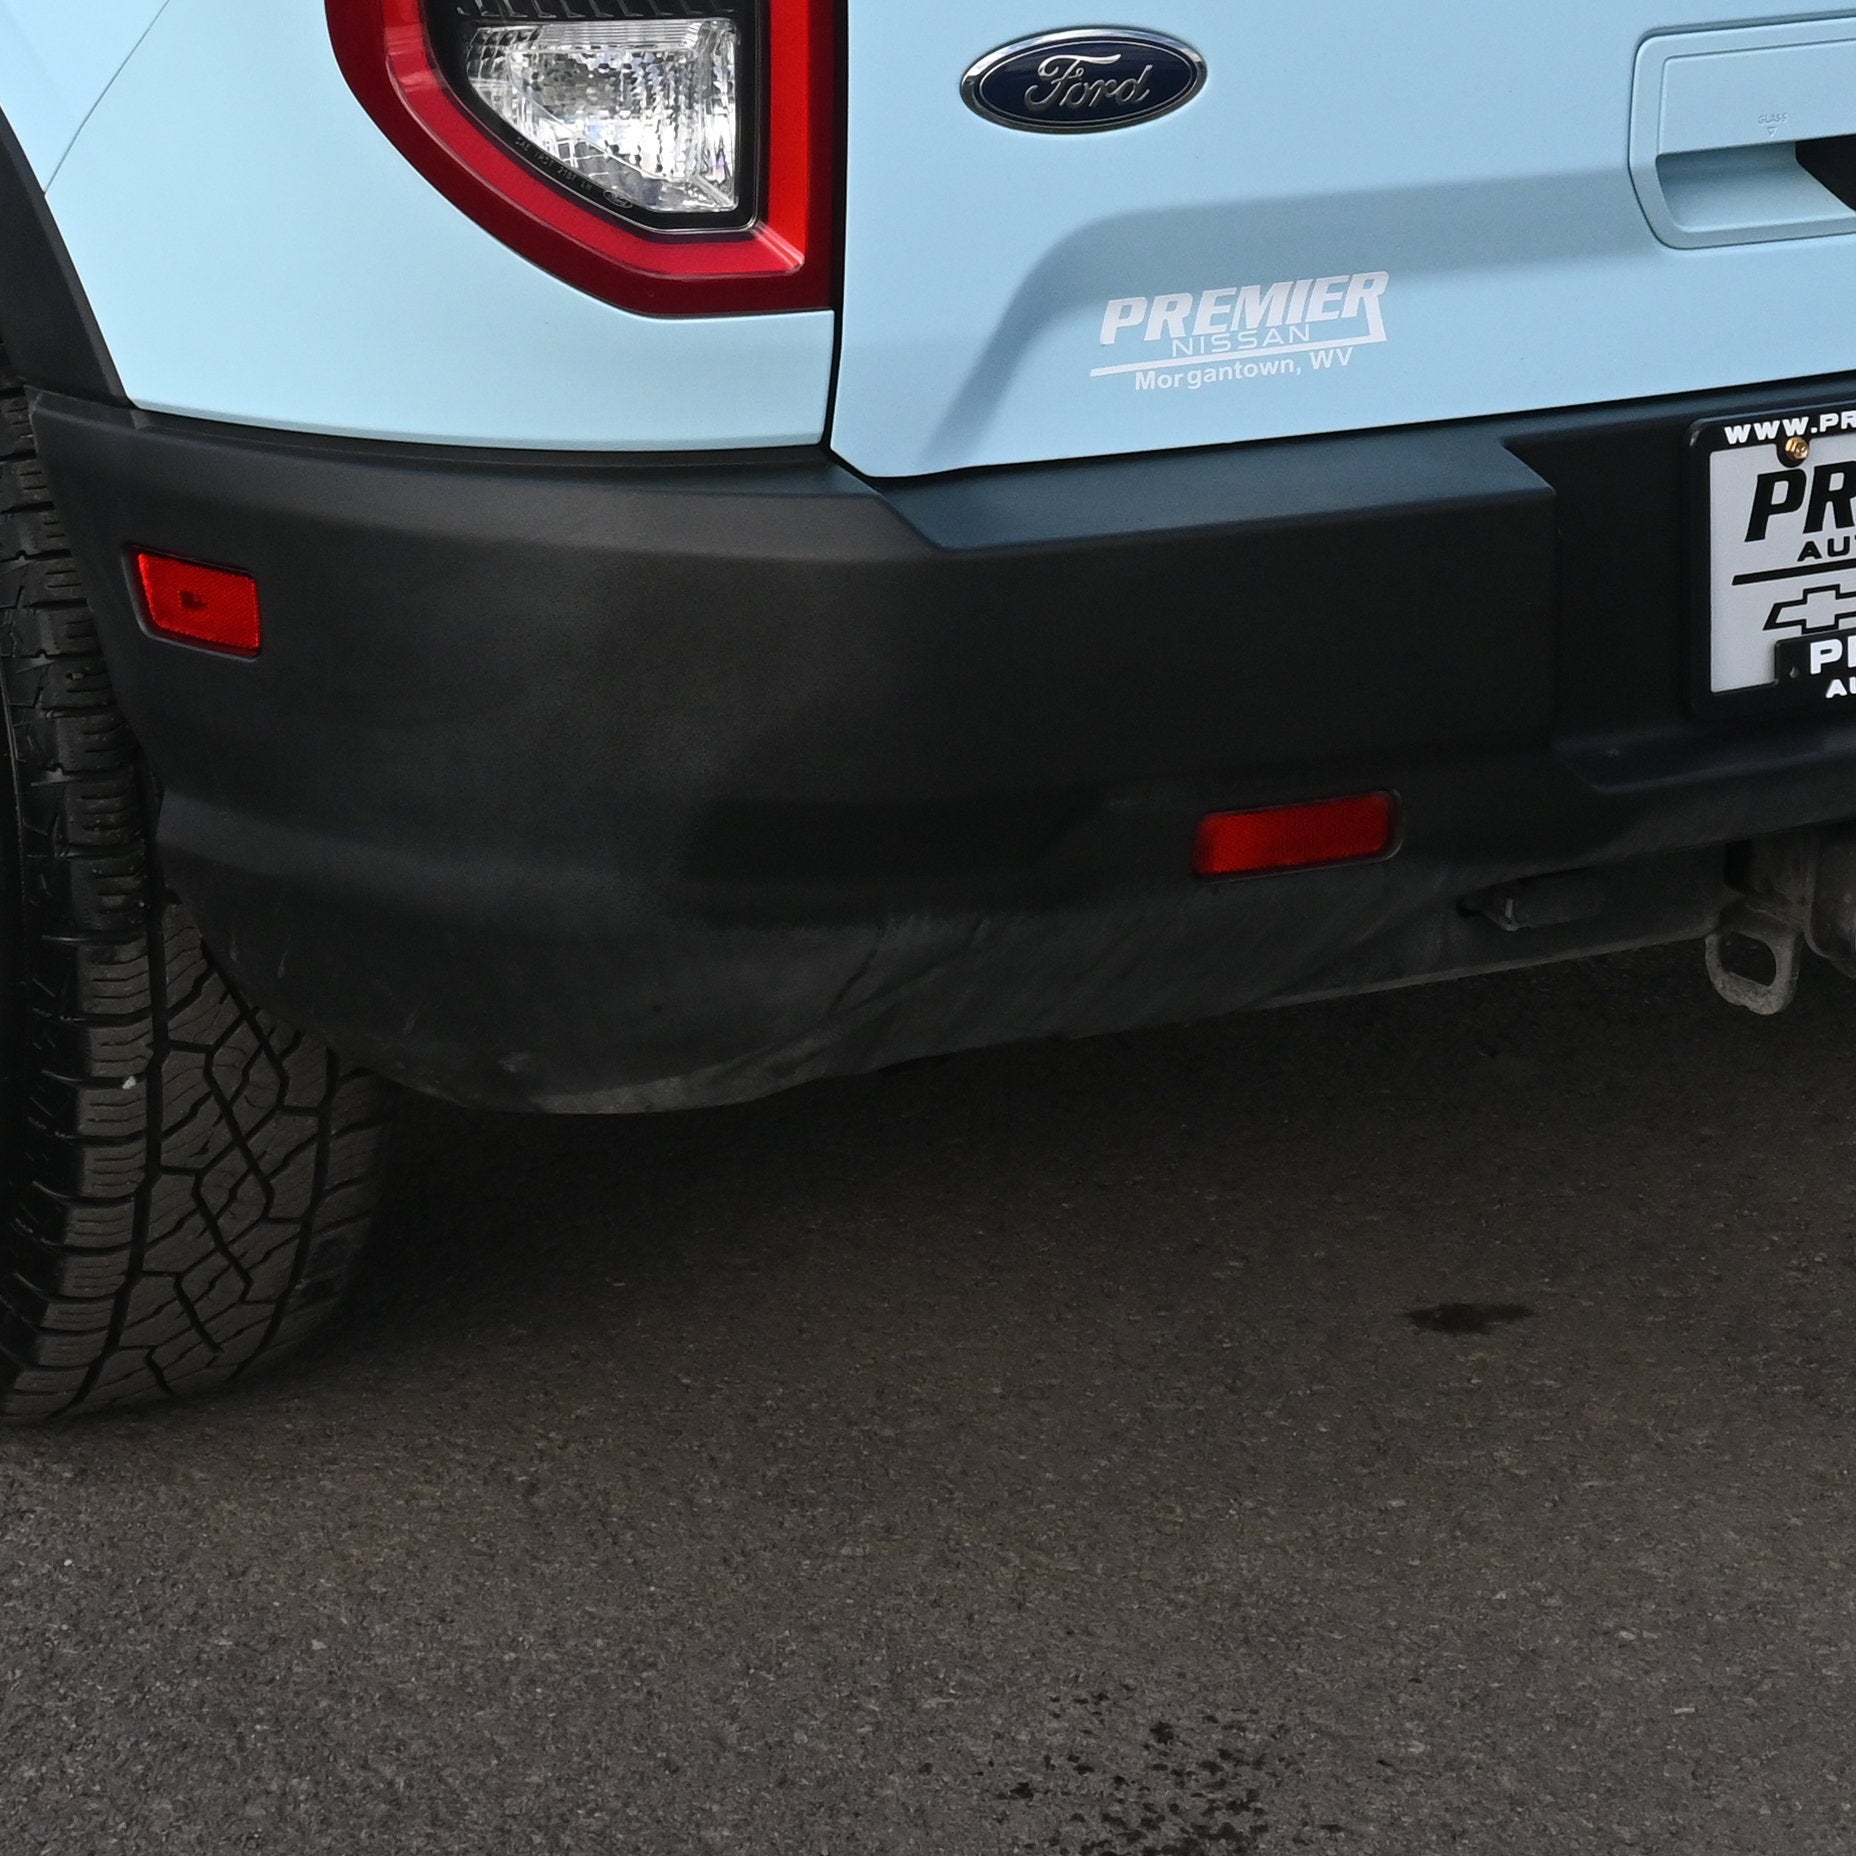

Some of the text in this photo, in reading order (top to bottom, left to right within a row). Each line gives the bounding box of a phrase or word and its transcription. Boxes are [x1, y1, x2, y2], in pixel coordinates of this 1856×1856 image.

[1024, 53, 1153, 111] Ford
[1100, 270, 1389, 345] PREMIER
[1172, 323, 1311, 357] NISSAN
[1135, 347, 1353, 390] Morgantown, WV
